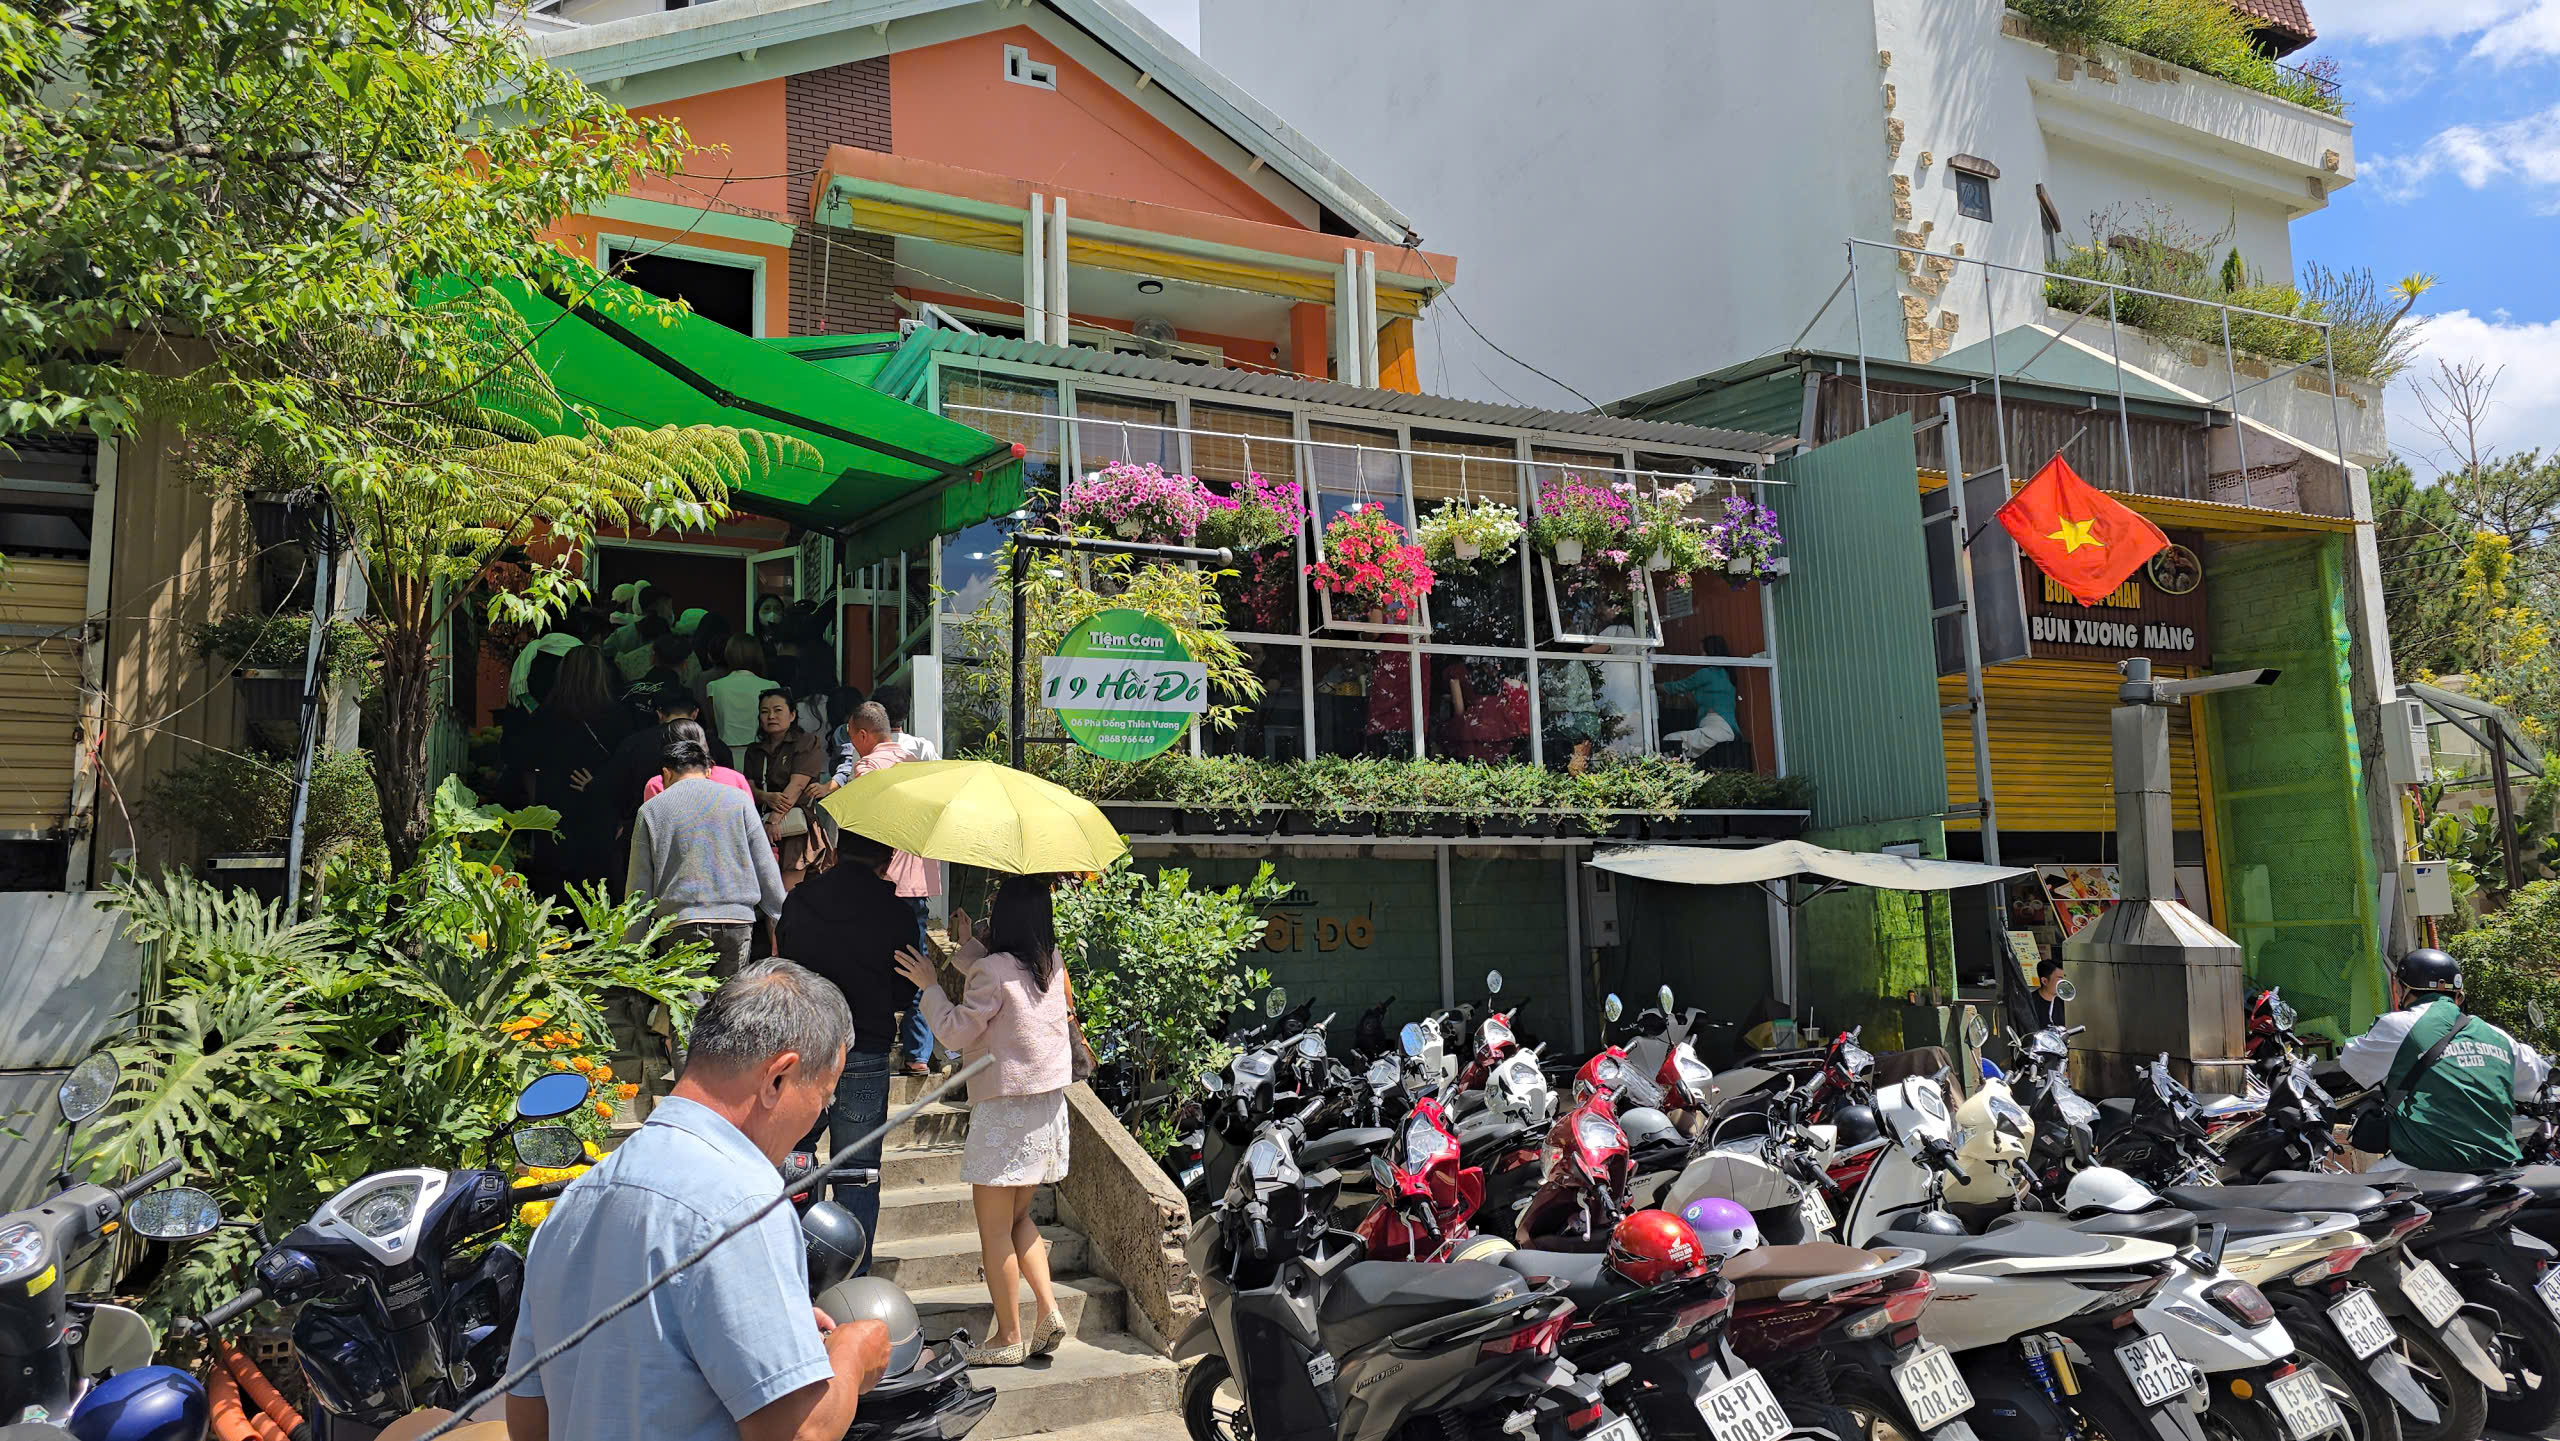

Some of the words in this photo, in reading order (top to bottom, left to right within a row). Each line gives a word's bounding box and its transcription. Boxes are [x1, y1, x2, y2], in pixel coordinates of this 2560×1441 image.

[1089, 631, 1127, 648] Tiệm
[1128, 633, 1164, 648] Cơm
[2032, 612, 2071, 643] BÚN
[2074, 619, 2138, 648] XƯƠNG
[2144, 622, 2195, 651] MĂNG
[1153, 670, 1202, 702] Đó
[1071, 718, 1083, 727] 06
[1098, 734, 1121, 743] 0868
[1121, 735, 1137, 744] 966
[1138, 735, 1155, 744] 449
[2456, 1054, 2485, 1067] CLUB
[2475, 1041, 2511, 1065] SOCIAL
[2422, 1284, 2460, 1323] 013.08
[2347, 1316, 2392, 1354] 590.09
[2123, 1338, 2169, 1372] 59-X4
[2136, 1363, 2187, 1400] 031.26
[2278, 1374, 2320, 1409] 15-AH
[1710, 1380, 1763, 1424] 49-P1
[1911, 1379, 1968, 1424] 208.49
[2288, 1399, 2335, 1437] 083.67
